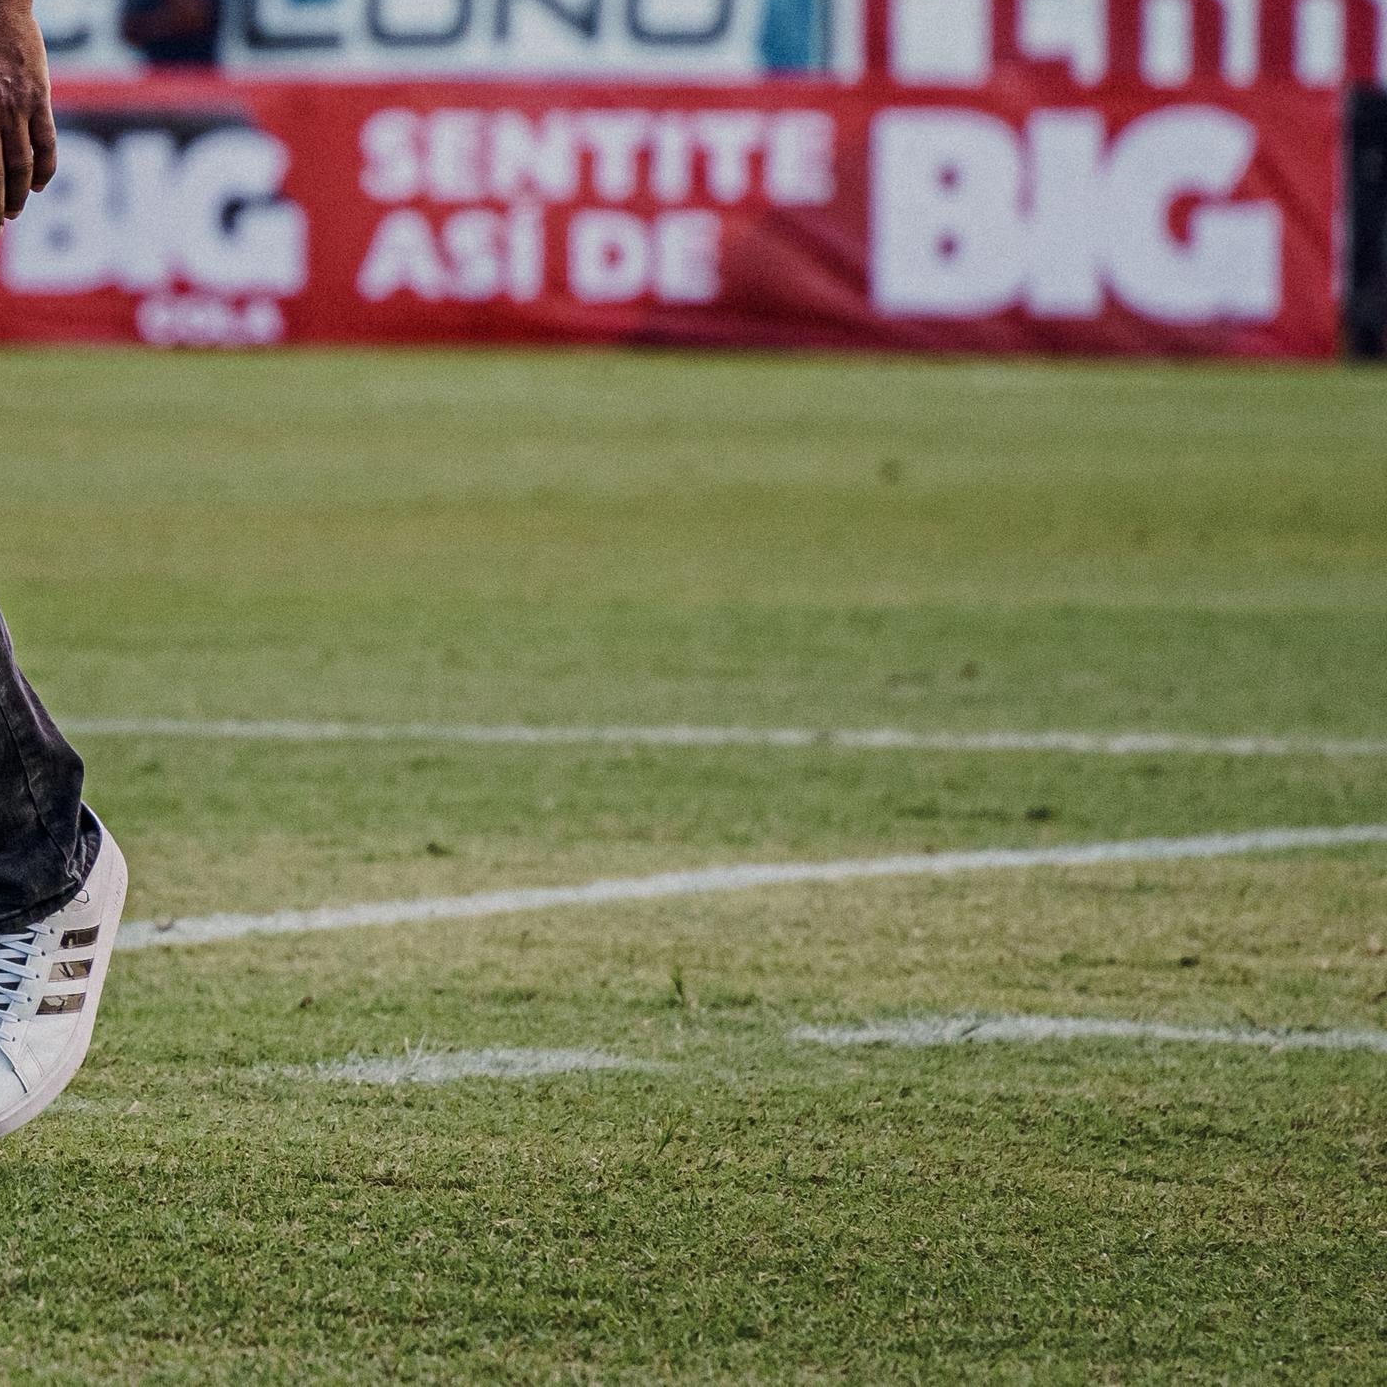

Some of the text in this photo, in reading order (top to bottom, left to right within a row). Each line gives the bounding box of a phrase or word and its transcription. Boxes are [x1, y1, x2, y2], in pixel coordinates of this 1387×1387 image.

[358, 108, 835, 205] SENTITE
[354, 201, 722, 303] ASÍ DE
[868, 104, 1283, 322] BIG
